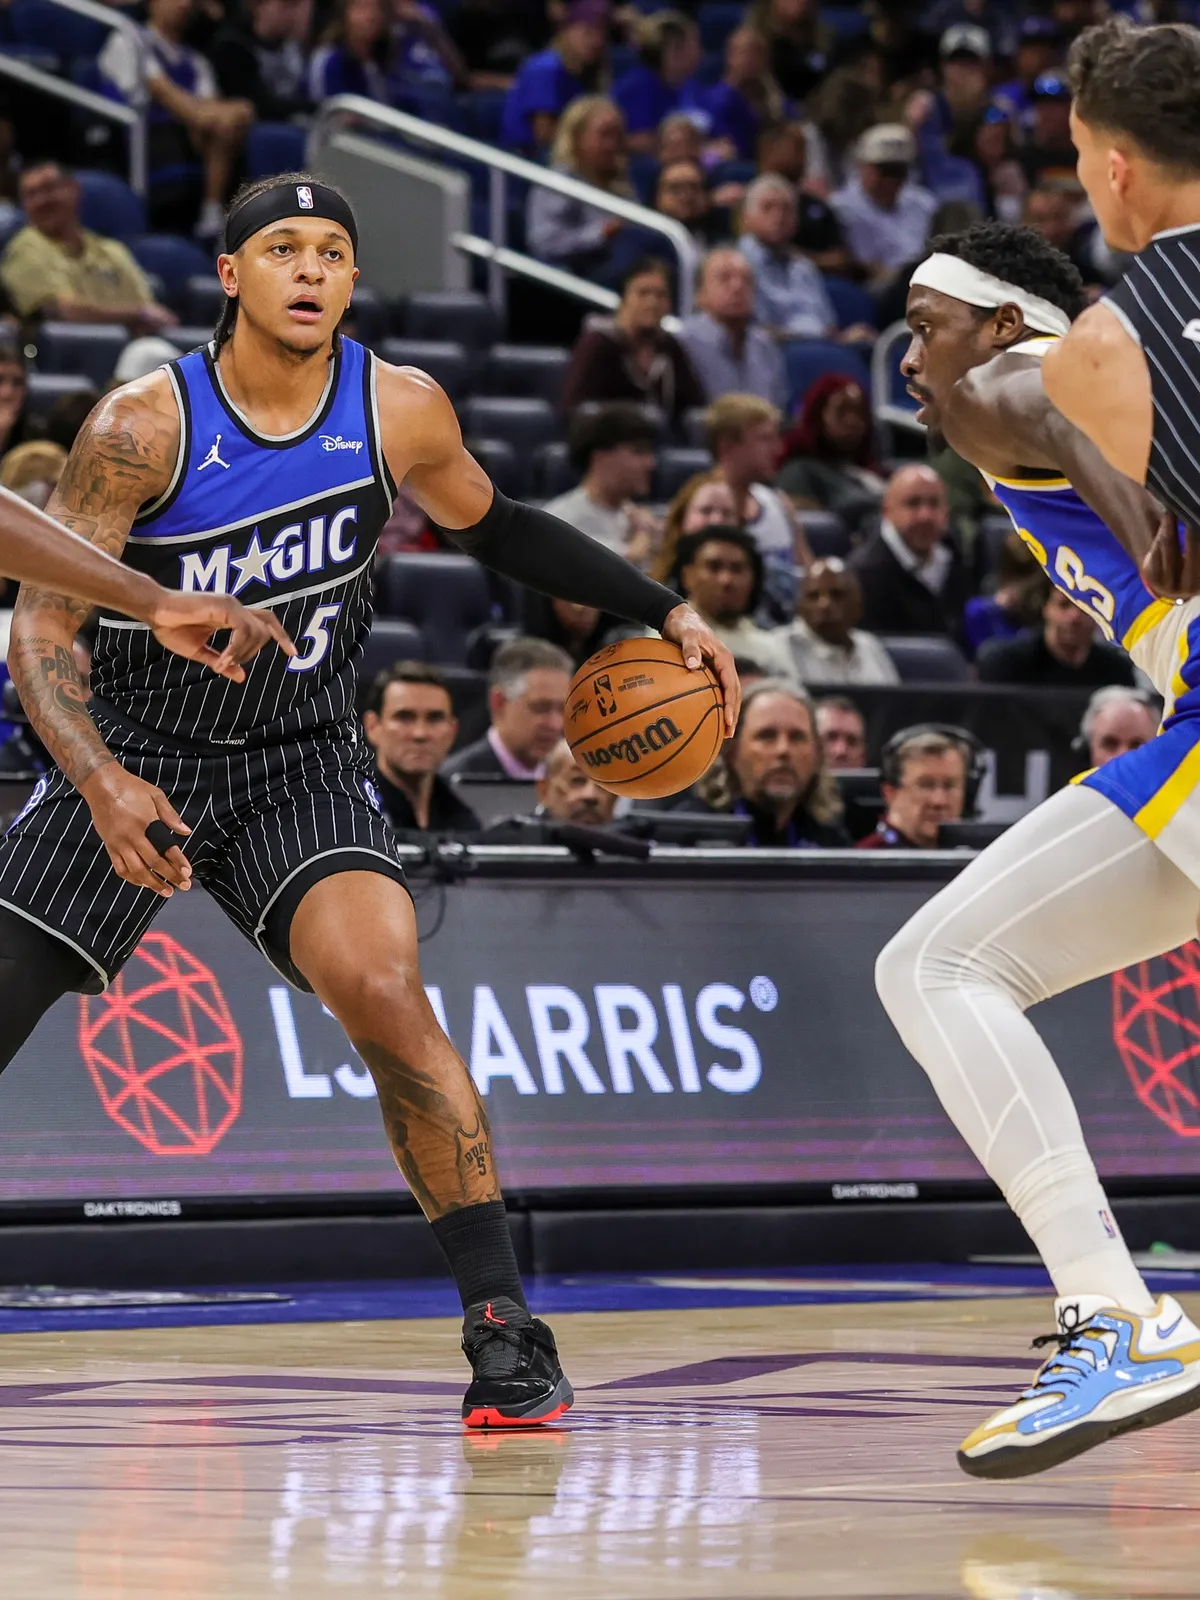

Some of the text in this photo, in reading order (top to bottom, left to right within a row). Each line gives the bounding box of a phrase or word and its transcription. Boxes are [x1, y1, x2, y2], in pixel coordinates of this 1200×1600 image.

[319, 435, 363, 455] Disney
[286, 602, 343, 672] 5
[581, 715, 684, 768] Wilson
[477, 1155, 487, 1176] 5
